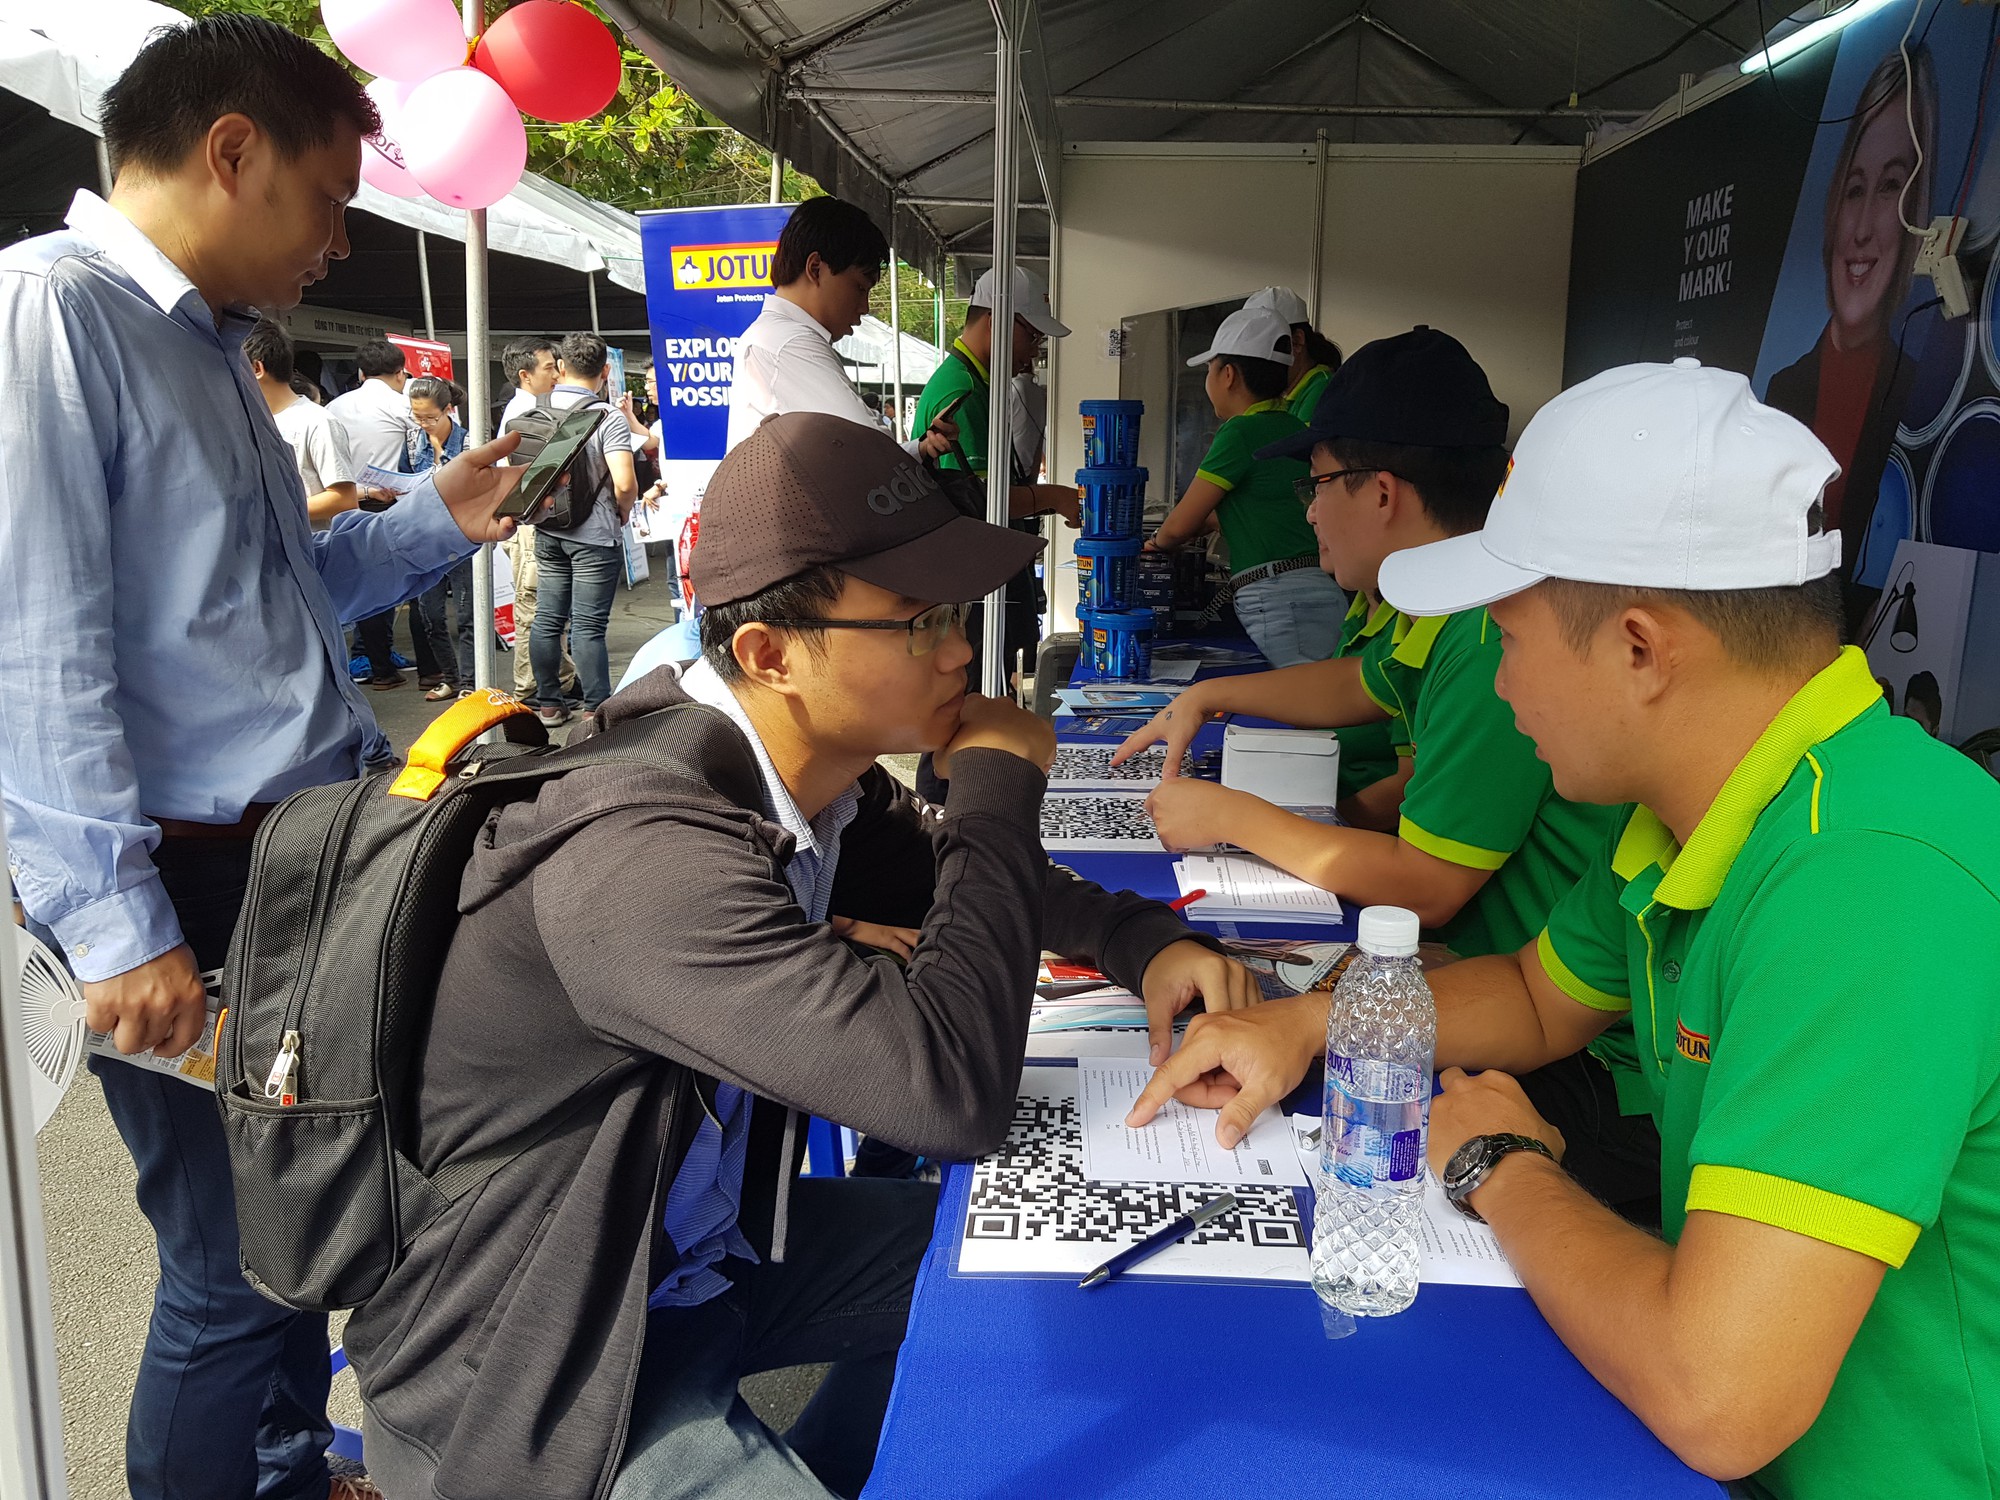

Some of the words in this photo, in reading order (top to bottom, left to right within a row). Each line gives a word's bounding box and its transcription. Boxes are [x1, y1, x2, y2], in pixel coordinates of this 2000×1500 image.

[1685, 184, 1735, 229] MAKE
[705, 254, 774, 282] JOTU
[1678, 260, 1733, 302] MARK!
[734, 293, 764, 302] Protects
